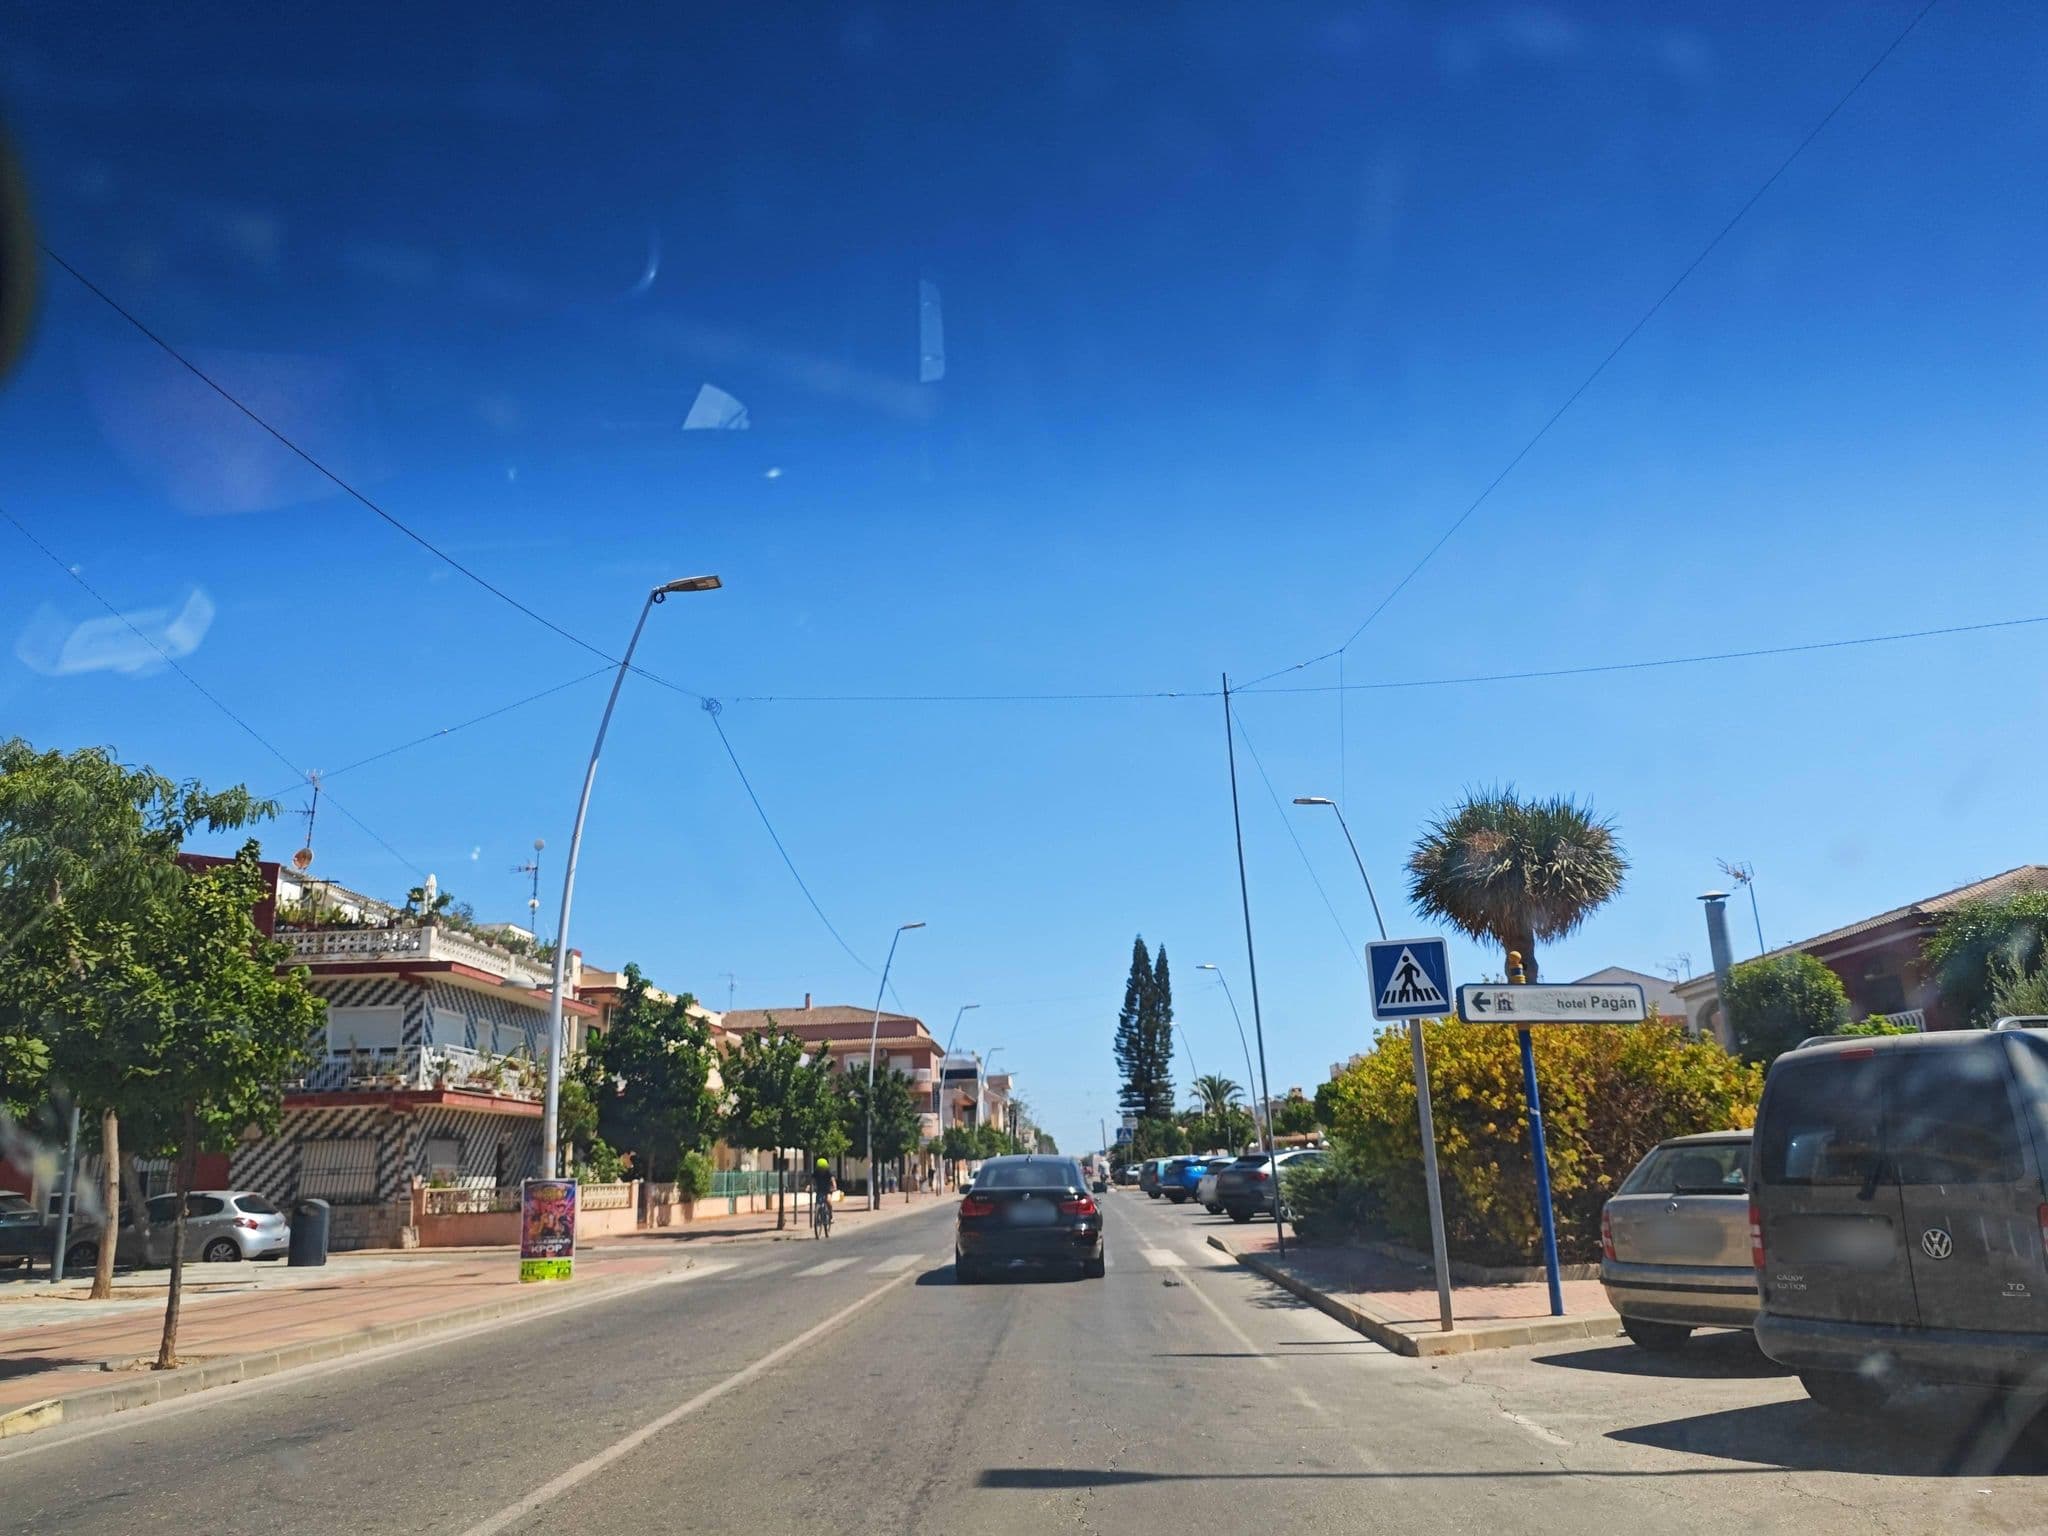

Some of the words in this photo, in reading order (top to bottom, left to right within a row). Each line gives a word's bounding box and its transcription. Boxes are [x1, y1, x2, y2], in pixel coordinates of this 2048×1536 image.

[1556, 998, 1587, 1009] hotel
[1590, 995, 1637, 1012] Pagán
[531, 1244, 562, 1253] KPOP
